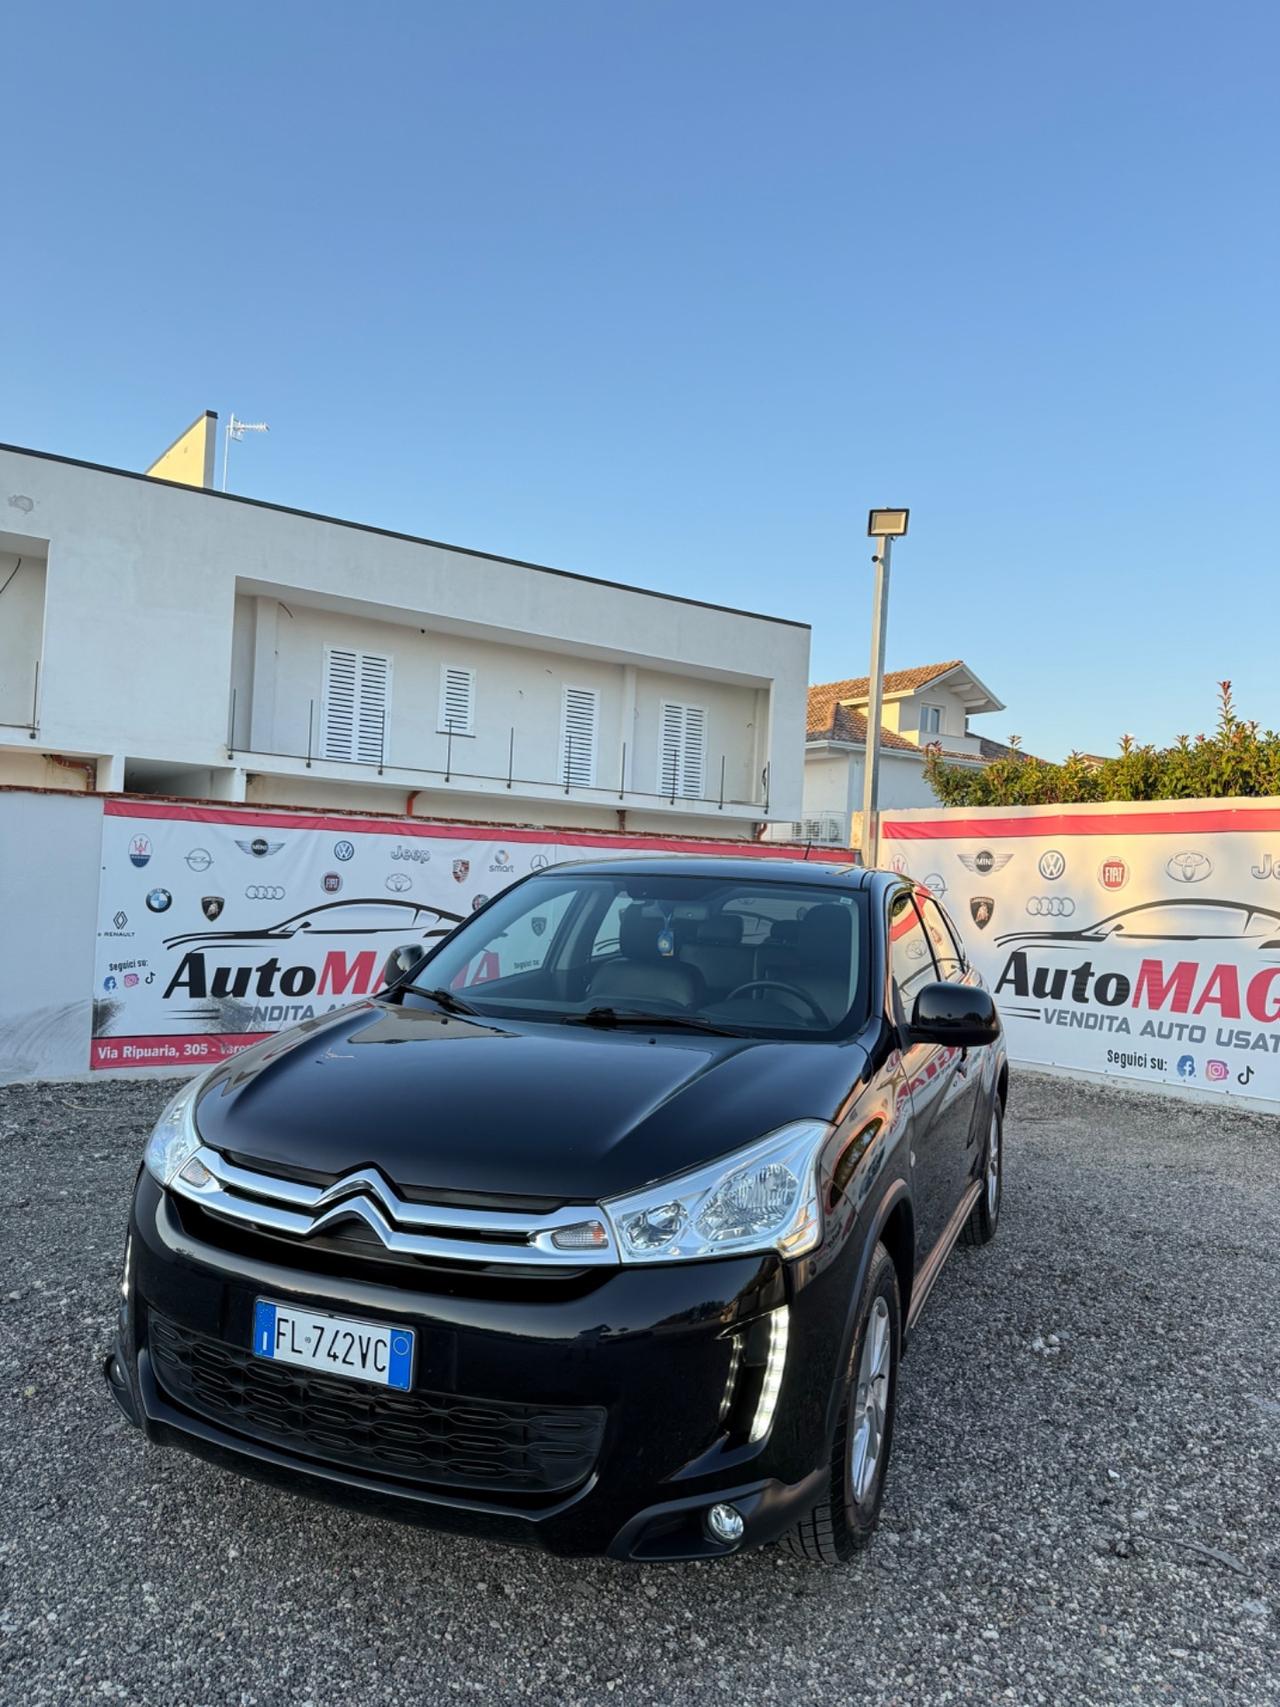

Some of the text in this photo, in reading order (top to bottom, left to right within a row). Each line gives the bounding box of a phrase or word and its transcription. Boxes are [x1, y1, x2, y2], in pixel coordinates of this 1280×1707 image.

[391, 845, 430, 864] Jeep
[489, 864, 514, 872] smart
[1104, 866, 1124, 883] FIAT
[109, 960, 136, 972] Seguici
[1044, 1008, 1131, 1035] VENDITA
[1139, 1020, 1207, 1044] AUTO
[98, 1047, 118, 1060] Via
[122, 1045, 180, 1058] Ripuaria,
[184, 1044, 208, 1056] 305
[1107, 1049, 1168, 1072] Seguici su:
